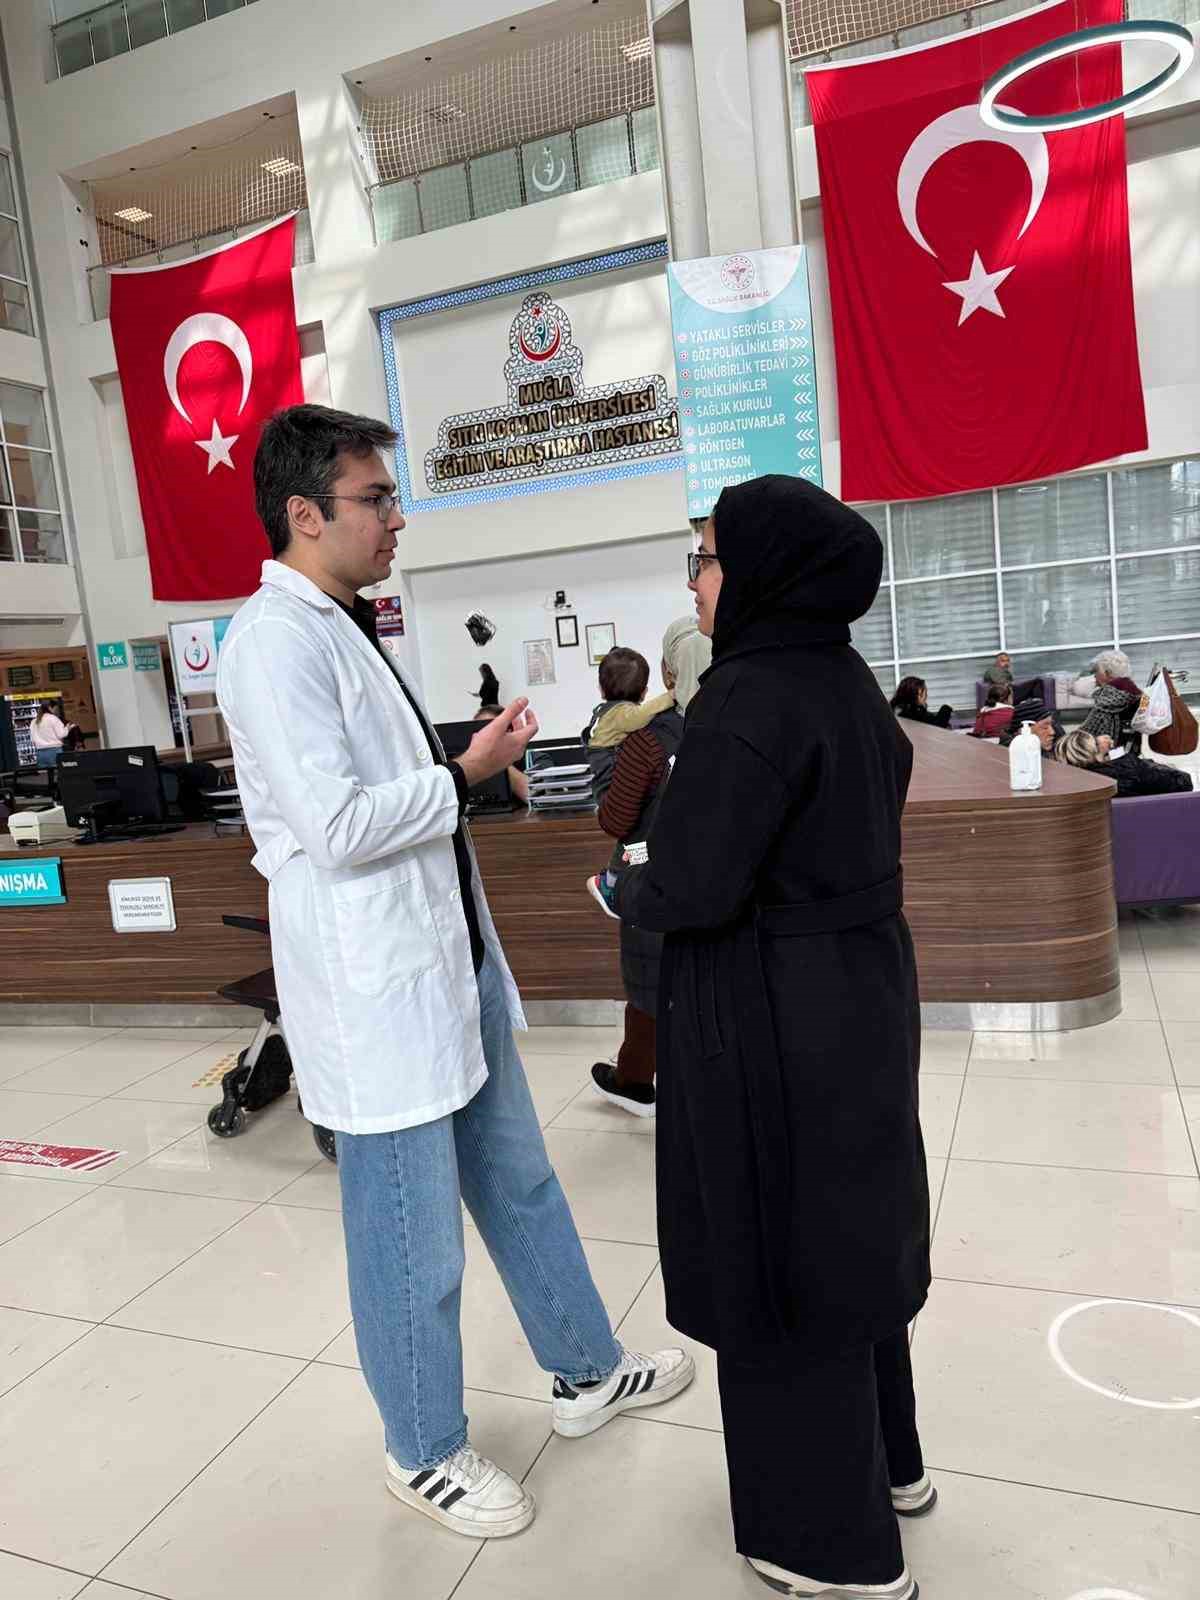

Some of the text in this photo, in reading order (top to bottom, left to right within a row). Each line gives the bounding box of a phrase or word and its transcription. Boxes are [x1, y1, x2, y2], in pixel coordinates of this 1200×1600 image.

[689, 319, 785, 343] YATAKLI SERVİSLER
[691, 336, 789, 362] GÖZ POLİKLİNİKLERİ
[693, 355, 789, 381] GÜNÜBİRLİK TEDAVİ
[518, 375, 575, 406] MUĞLA
[695, 378, 768, 399] POLİKLİNİKLER
[448, 384, 657, 449] SITKI KOÇMAN ÜNİVERSİTESİ
[696, 396, 772, 418] SAĞLIK KURULU
[697, 413, 786, 436] LABORATUVARLAR
[434, 410, 680, 480] EĞİTİM VE ARAŞTIRMA HASTANESİ
[699, 436, 745, 454] RÖNTGEN
[700, 455, 752, 472] ULTRASON
[102, 655, 125, 667] BLOK
